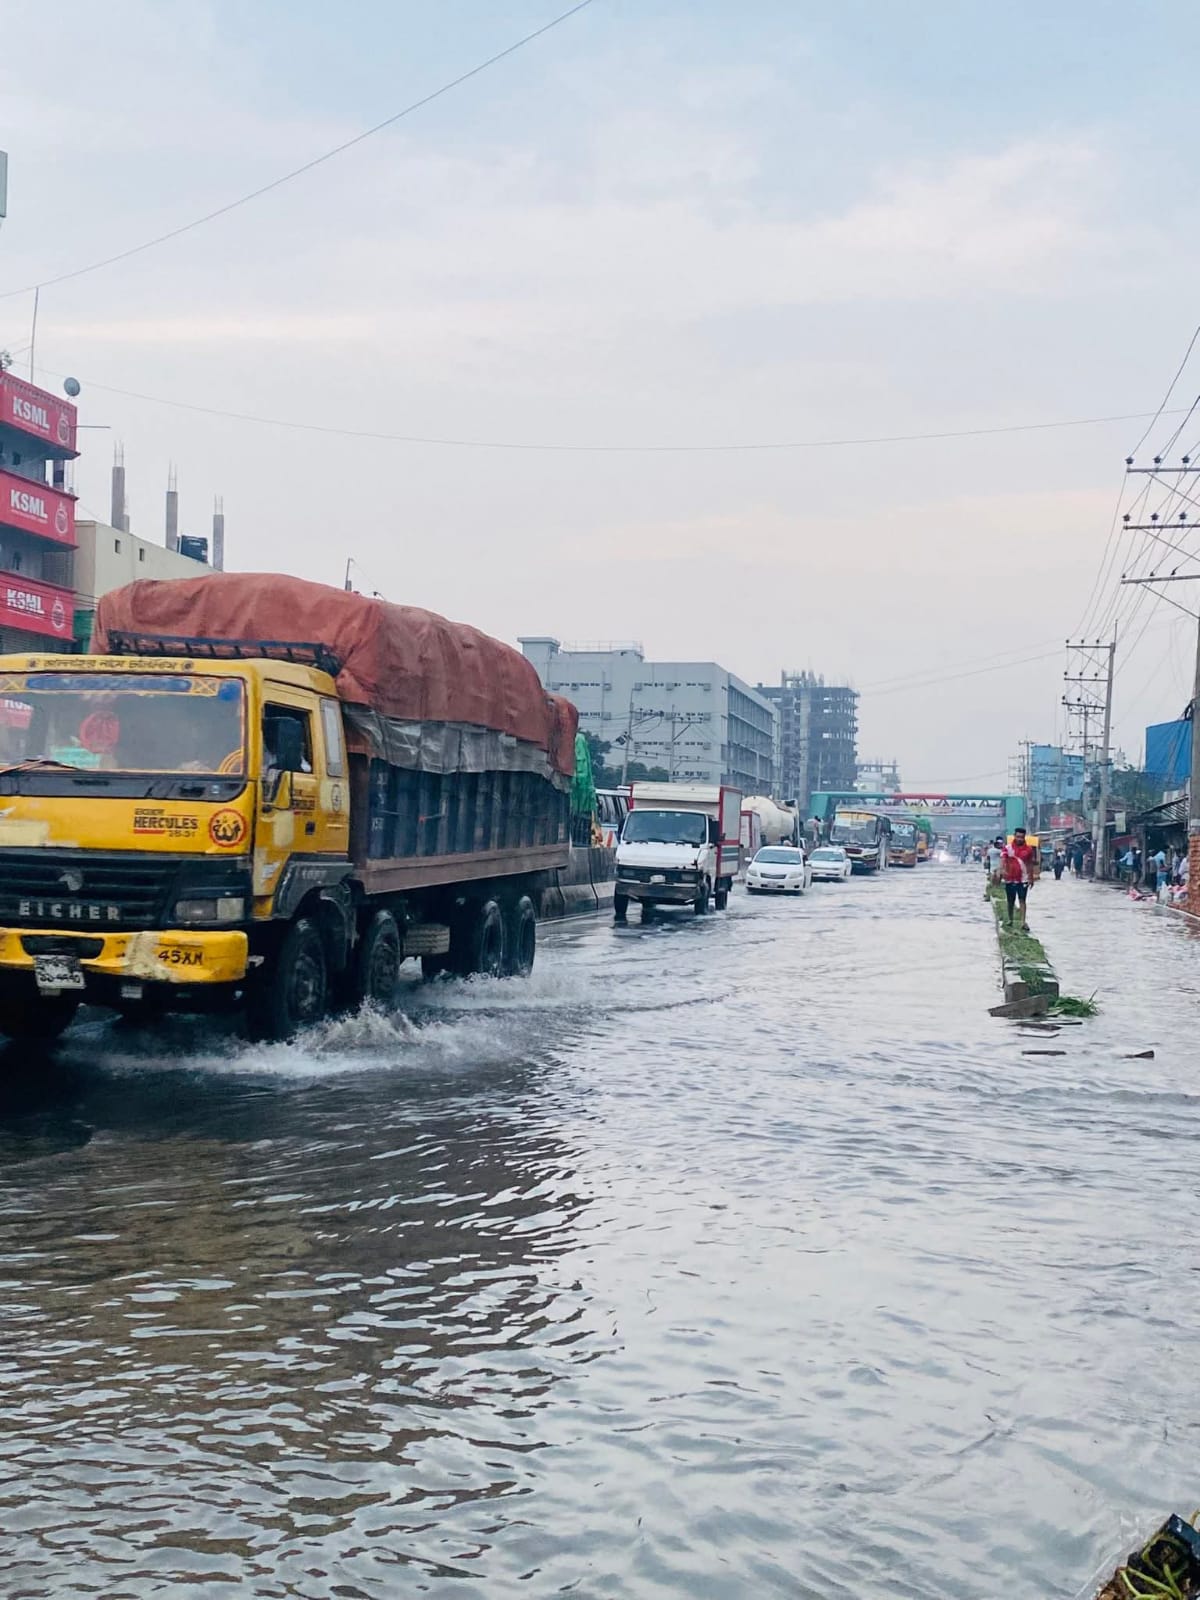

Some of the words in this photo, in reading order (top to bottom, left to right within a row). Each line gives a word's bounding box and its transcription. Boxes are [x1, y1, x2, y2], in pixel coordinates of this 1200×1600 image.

[13, 396, 50, 430] KSML
[11, 489, 48, 519] KSML
[7, 588, 45, 614] KSML
[134, 817, 198, 829] HERCULES
[19, 900, 120, 920] EICHER
